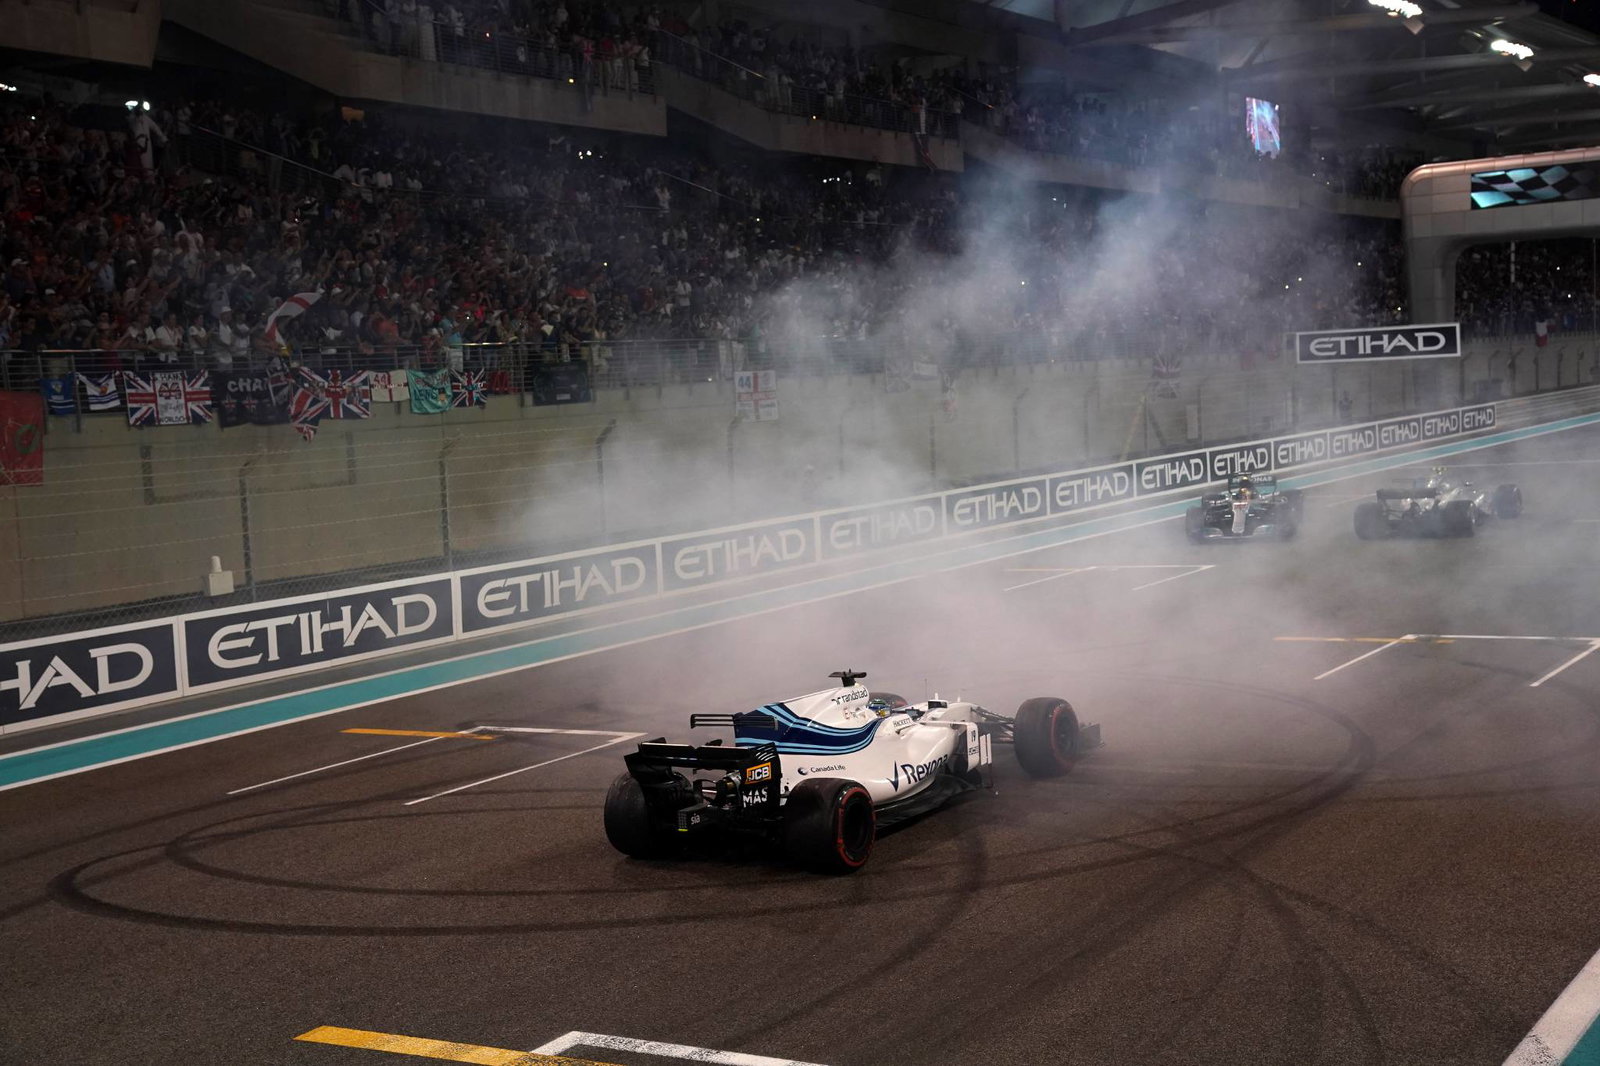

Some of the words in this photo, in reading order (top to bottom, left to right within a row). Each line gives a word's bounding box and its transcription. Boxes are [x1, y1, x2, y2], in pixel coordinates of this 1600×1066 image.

[1310, 332, 1446, 356] ETIHAD
[1424, 415, 1459, 436] ETIHAD
[1463, 408, 1494, 428] ETIHAD
[1333, 430, 1375, 454] ETIHAD
[1381, 422, 1419, 445] ETIHAD
[1214, 448, 1268, 476] ETIHAD
[1278, 438, 1325, 464] ETIHAD
[1141, 458, 1204, 489] ETIHAD
[1056, 472, 1129, 506] ETIHAD
[953, 487, 1041, 525] ETIHAD
[830, 506, 936, 549] ETIHAD
[674, 528, 806, 579] ETIHAD
[477, 557, 647, 618] ETIHAD
[208, 593, 437, 669] ETIHAD
[842, 688, 868, 704] randstad
[748, 766, 770, 781] JCB
[811, 765, 834, 773] Canada
